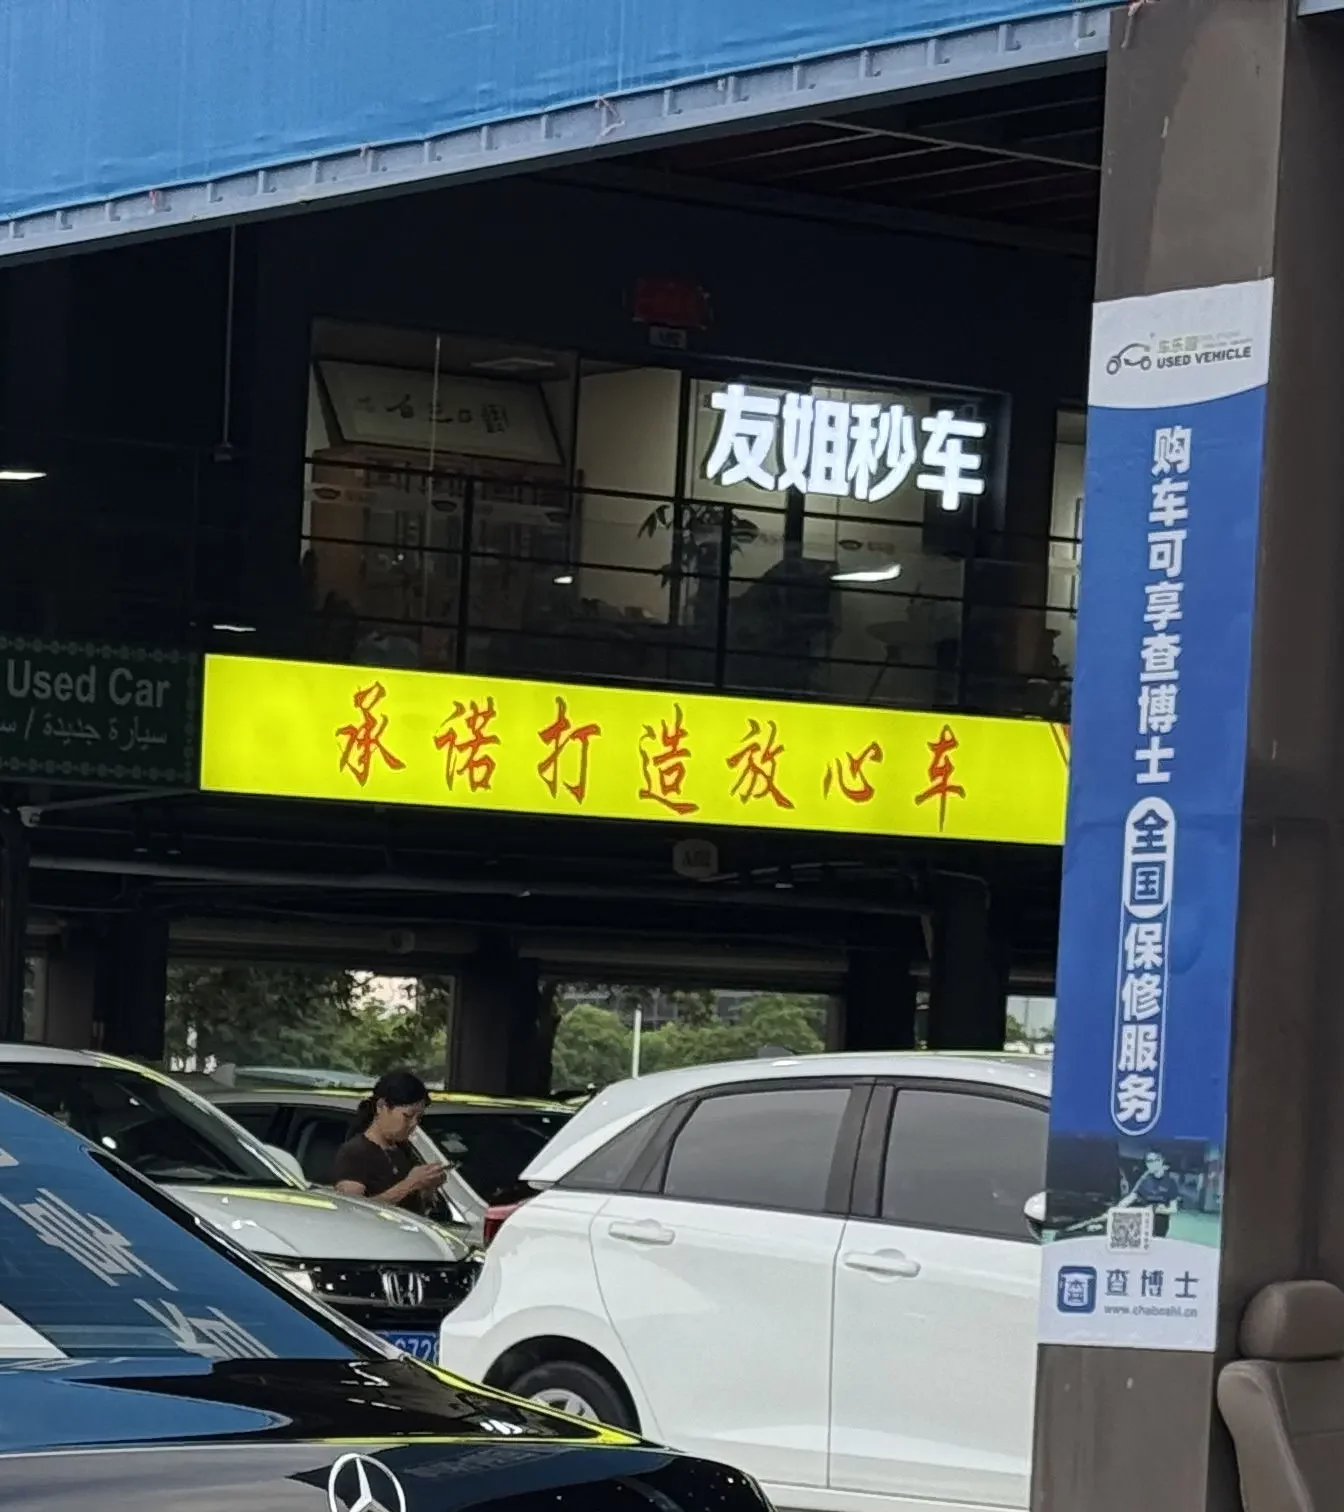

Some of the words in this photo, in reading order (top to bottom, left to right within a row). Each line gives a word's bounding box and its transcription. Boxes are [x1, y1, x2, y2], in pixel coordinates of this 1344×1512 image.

[1157, 354, 1191, 370] USED
[1195, 346, 1253, 365] VEHICLE
[706, 382, 986, 512] 友姐秒车
[1134, 425, 1193, 786] 购车可享查博士
[8, 659, 97, 704] Used
[109, 667, 171, 709] Car
[335, 679, 967, 832] 承诺打造放心车
[1116, 808, 1170, 1125] 全国保修服务
[1104, 1268, 1200, 1300] 查博士
